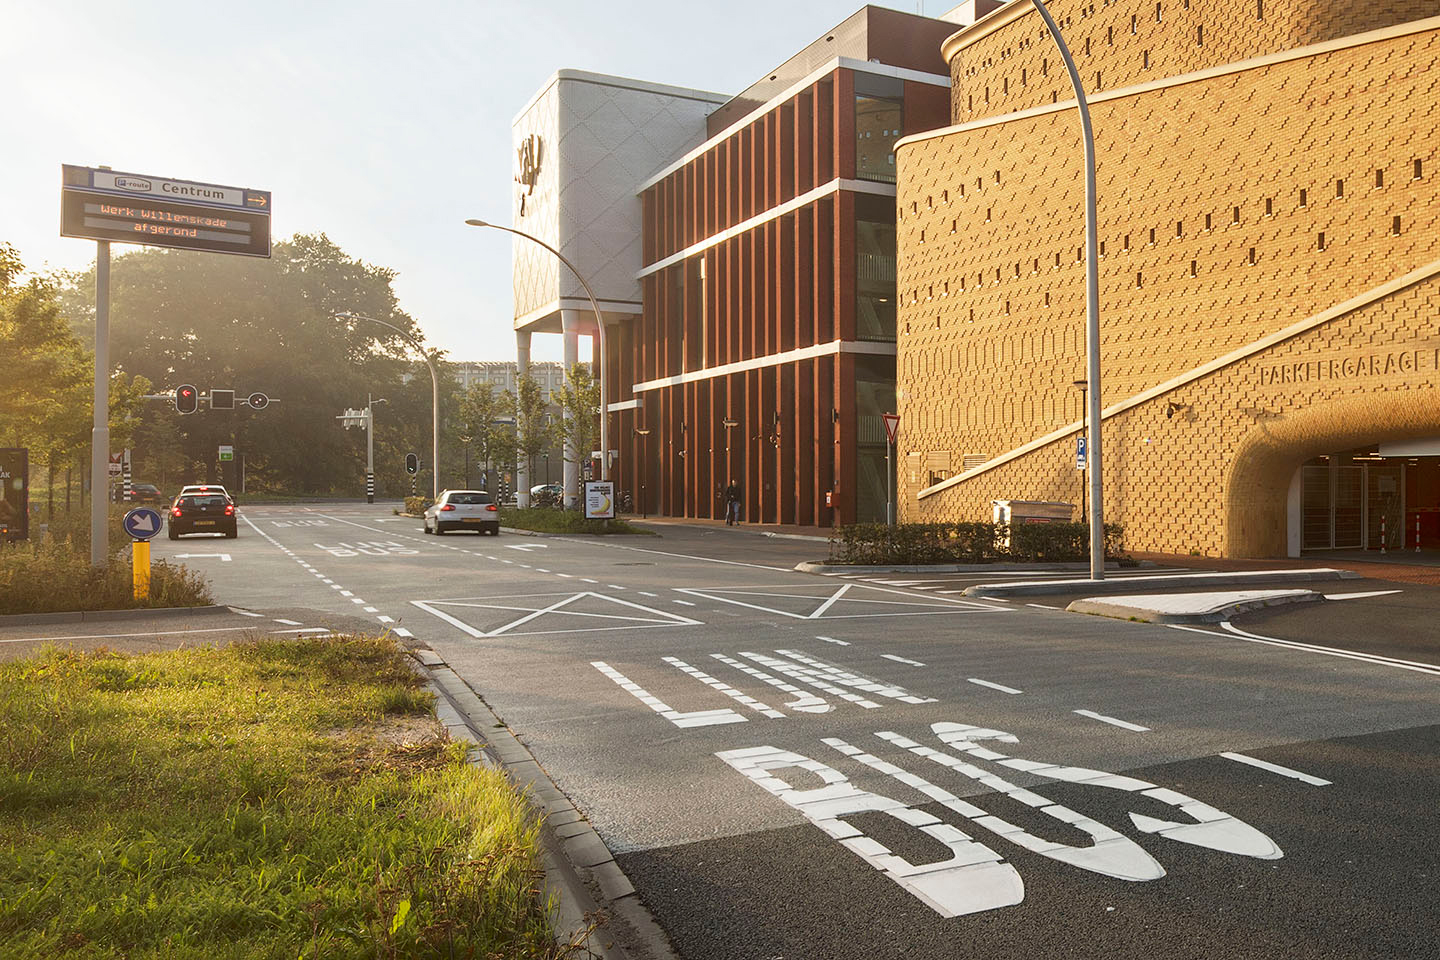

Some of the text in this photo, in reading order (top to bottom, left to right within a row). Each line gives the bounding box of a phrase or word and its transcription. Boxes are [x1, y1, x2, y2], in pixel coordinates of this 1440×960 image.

[162, 182, 225, 200] Centrum
[100, 204, 228, 228] Werk Willemskade
[134, 222, 198, 238] afgerond
[1260, 349, 1427, 386] PARKEERGARAGE
[1079, 440, 1084, 452] P
[590, 649, 939, 728] LIJN
[714, 722, 1285, 918] BUS
